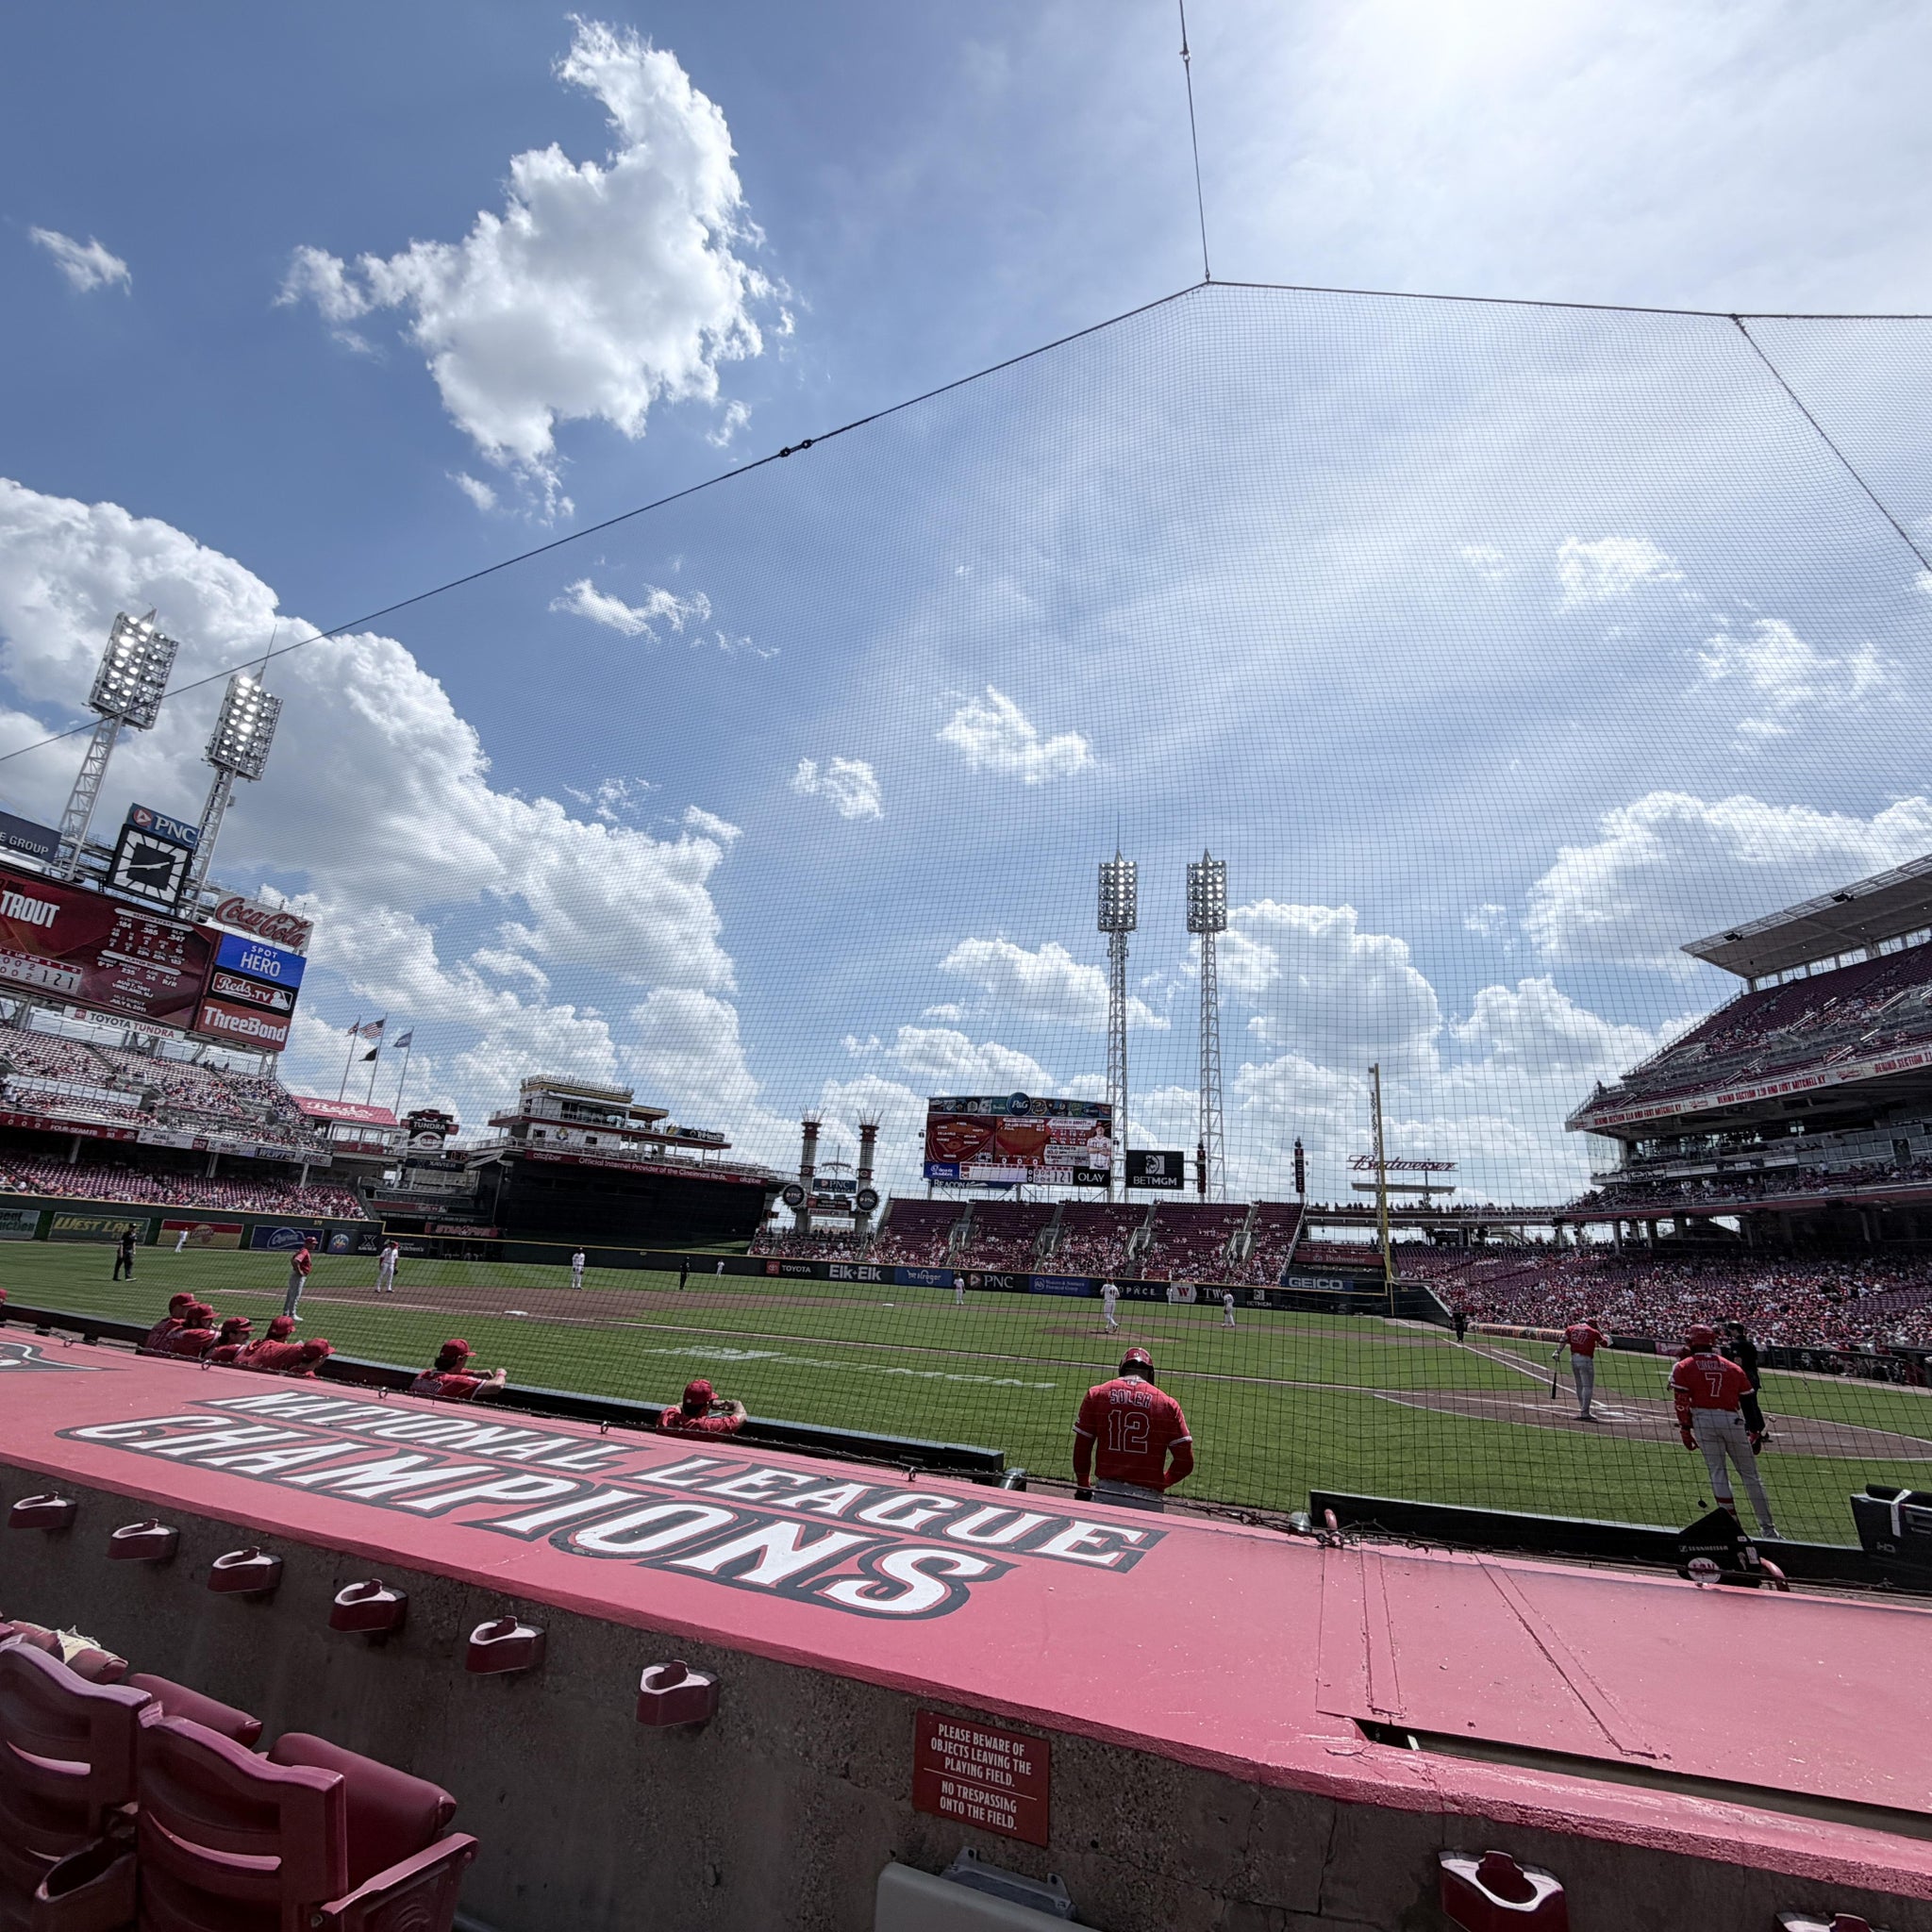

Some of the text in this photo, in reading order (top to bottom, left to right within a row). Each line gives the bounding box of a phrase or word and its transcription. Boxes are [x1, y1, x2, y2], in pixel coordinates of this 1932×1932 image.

[155, 815, 197, 844] PNC
[9, 835, 49, 855] GROUP
[0, 890, 60, 928] TROUT
[216, 897, 311, 947] Coca-Cola
[251, 945, 278, 958] SPOT
[240, 952, 281, 977] HERO
[162, 979, 177, 988] R/R
[90, 1013, 174, 1038] TOYOTA TUNDRA
[204, 1006, 287, 1042] ThreeBond
[1874, 1054, 1923, 1073] BEHIND SECTION
[1717, 1075, 1826, 1103] BEHIND SECTION AND FORT MITCHELL KY
[413, 1121, 446, 1131] TUNDRA
[1594, 1116, 1608, 1126] BEHIND
[1609, 1113, 1625, 1123] SECTION
[1635, 1110, 1644, 1118] AND
[1644, 1108, 1655, 1117] FORT
[1655, 1106, 1675, 1115] MITCHELL
[578, 1157, 604, 1166] Official
[605, 1160, 631, 1170] Internet
[632, 1163, 659, 1174] Provider
[679, 1169, 710, 1178] Cincinnati
[1347, 1155, 1457, 1171] Budweiser
[934, 1179, 967, 1188] BEACON
[1078, 1172, 1105, 1183] OLAY
[1133, 1176, 1177, 1185] BETMGM
[54, 1217, 102, 1231] WEST
[1326, 1254, 1366, 1263] Budweiser
[782, 1265, 811, 1273] TOYOTA
[917, 1270, 941, 1284] Kroger
[984, 1275, 1014, 1288] PNC
[1288, 1277, 1343, 1290] GEICO
[1571, 1331, 1588, 1345] 27
[1704, 1372, 1722, 1397] 7
[1108, 1409, 1150, 1454] 12
[200, 1390, 1145, 1566] NATIONAL LEAGUE
[72, 1414, 995, 1614] CHAMPIONS
[938, 1723, 1025, 1757] PLEASE BEWARE OF
[931, 1737, 1032, 1775] OBJECTS LEAVING THE
[945, 1757, 1015, 1787] PLAYING FIELD.
[942, 1781, 1017, 1813] NO TRESPASSING
[940, 1797, 1017, 1830] ONTO THE FIELD.
